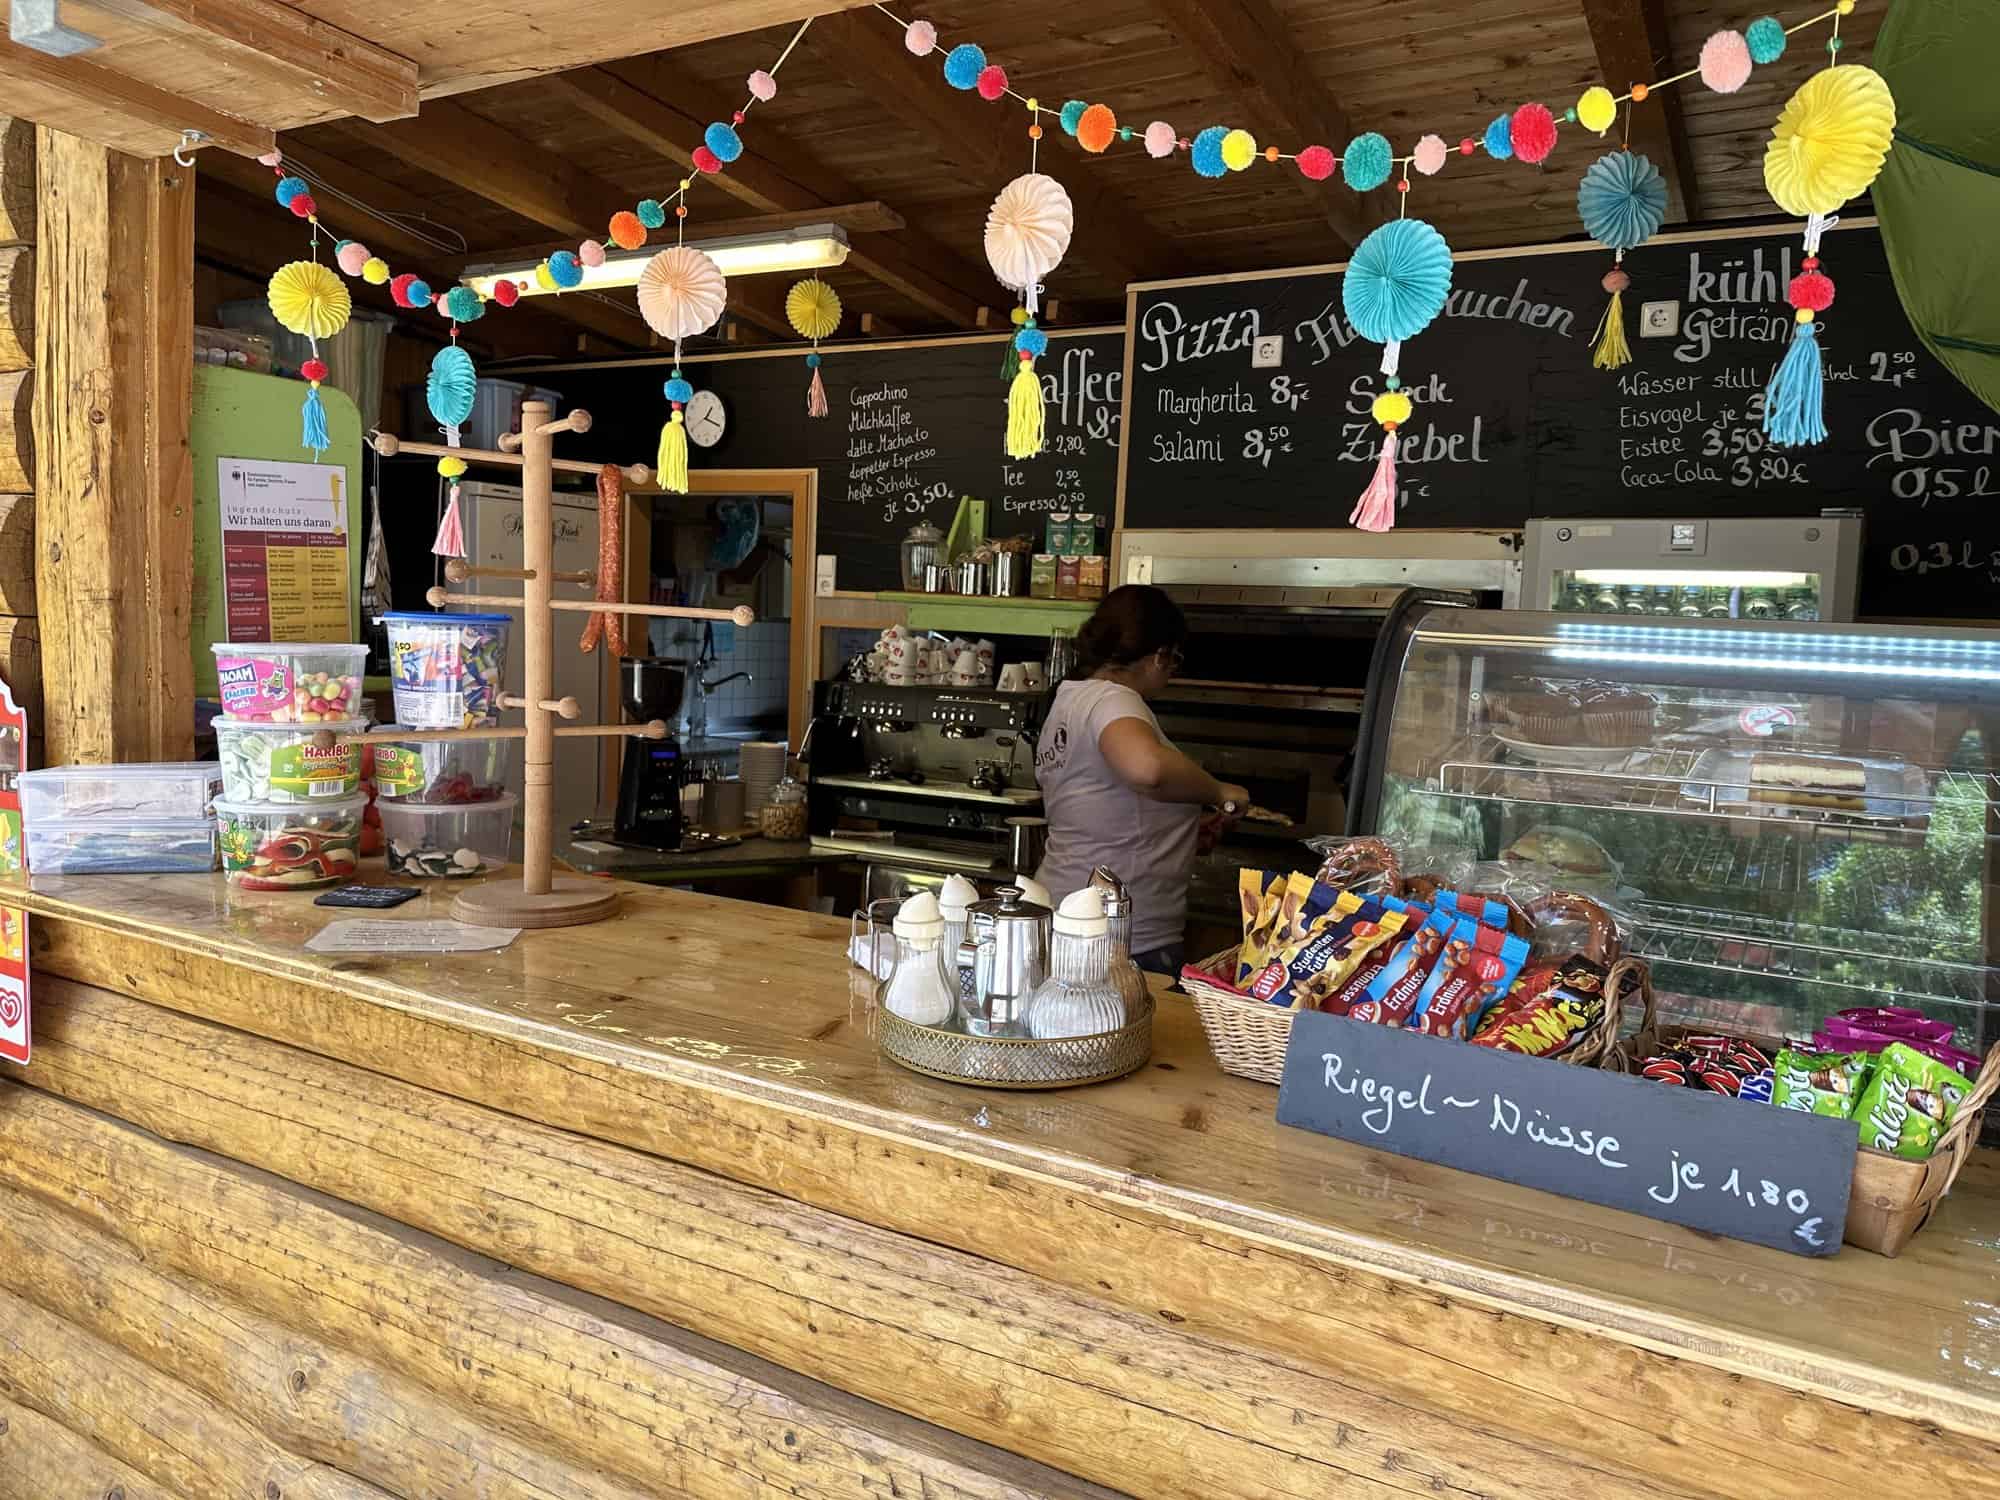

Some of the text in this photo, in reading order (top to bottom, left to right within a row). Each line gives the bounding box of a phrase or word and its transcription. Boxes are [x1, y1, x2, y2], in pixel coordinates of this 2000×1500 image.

[1688, 247, 1822, 304] kühl
[1141, 301, 1260, 372] Pizza
[1030, 348, 1123, 427] affee
[1345, 373, 1454, 415] Seck
[1617, 370, 1702, 396] Wasser
[1711, 367, 1761, 388] still
[848, 405, 913, 433] Milchkaffee
[1620, 399, 1708, 433] Eisvogel
[1712, 403, 1740, 430] je
[1148, 430, 1225, 463] Salami
[1337, 415, 1489, 464] Ziebel
[1620, 436, 1685, 461] Eistee
[849, 447, 936, 481] doppelter Espresso
[1001, 464, 1026, 487] Tee
[1620, 458, 1724, 488] Coca-Cola
[847, 471, 921, 505] heiße Schoki
[1002, 494, 1057, 516] Espresso
[1891, 467, 1969, 509] 0,5
[228, 514, 331, 528] Wir halten uns daran
[883, 498, 900, 522] je
[1890, 541, 1953, 575] 0,3
[303, 744, 350, 758] HARIBO
[1292, 933, 1335, 974] Studenten
[1307, 944, 1336, 975] Futter
[1254, 964, 1284, 996] ültje
[1383, 967, 1428, 1012] Erdnüsse
[1429, 977, 1468, 1017] Erdnüsse
[1320, 1052, 1438, 1135] Riegel
[1486, 1090, 1631, 1169] Nüsse
[1647, 1150, 1706, 1205] je
[1720, 1166, 1810, 1214] 1,80
[1792, 1215, 1827, 1248] €
